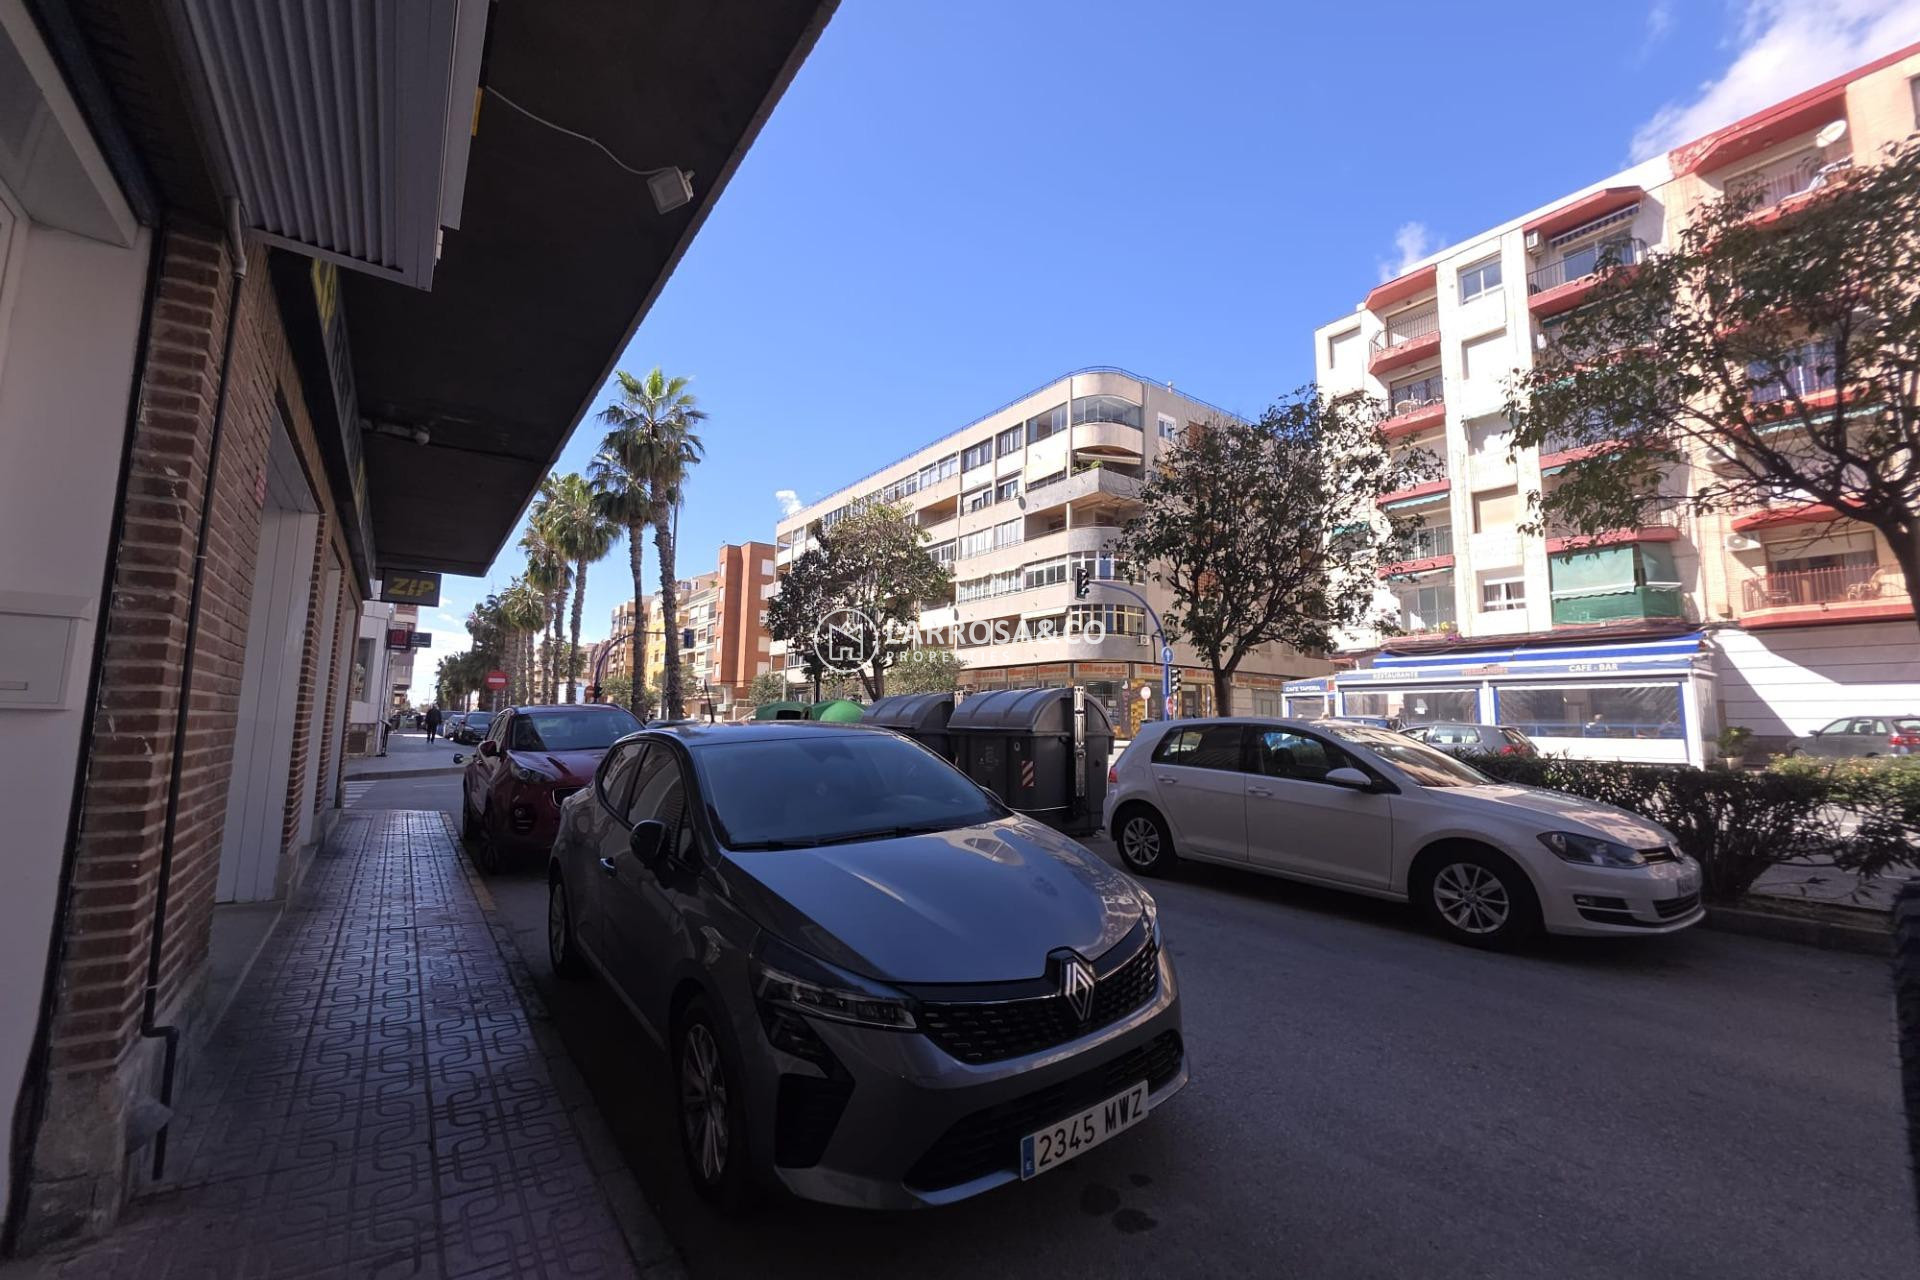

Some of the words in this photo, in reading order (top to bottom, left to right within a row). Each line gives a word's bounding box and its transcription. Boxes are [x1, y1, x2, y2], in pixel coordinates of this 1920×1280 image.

[387, 577, 436, 597] ZIP
[1568, 664, 1592, 673] CAFE
[1599, 663, 1619, 672] BAR
[1038, 1114, 1095, 1168] 2345
[1105, 1088, 1143, 1134] MWZ
